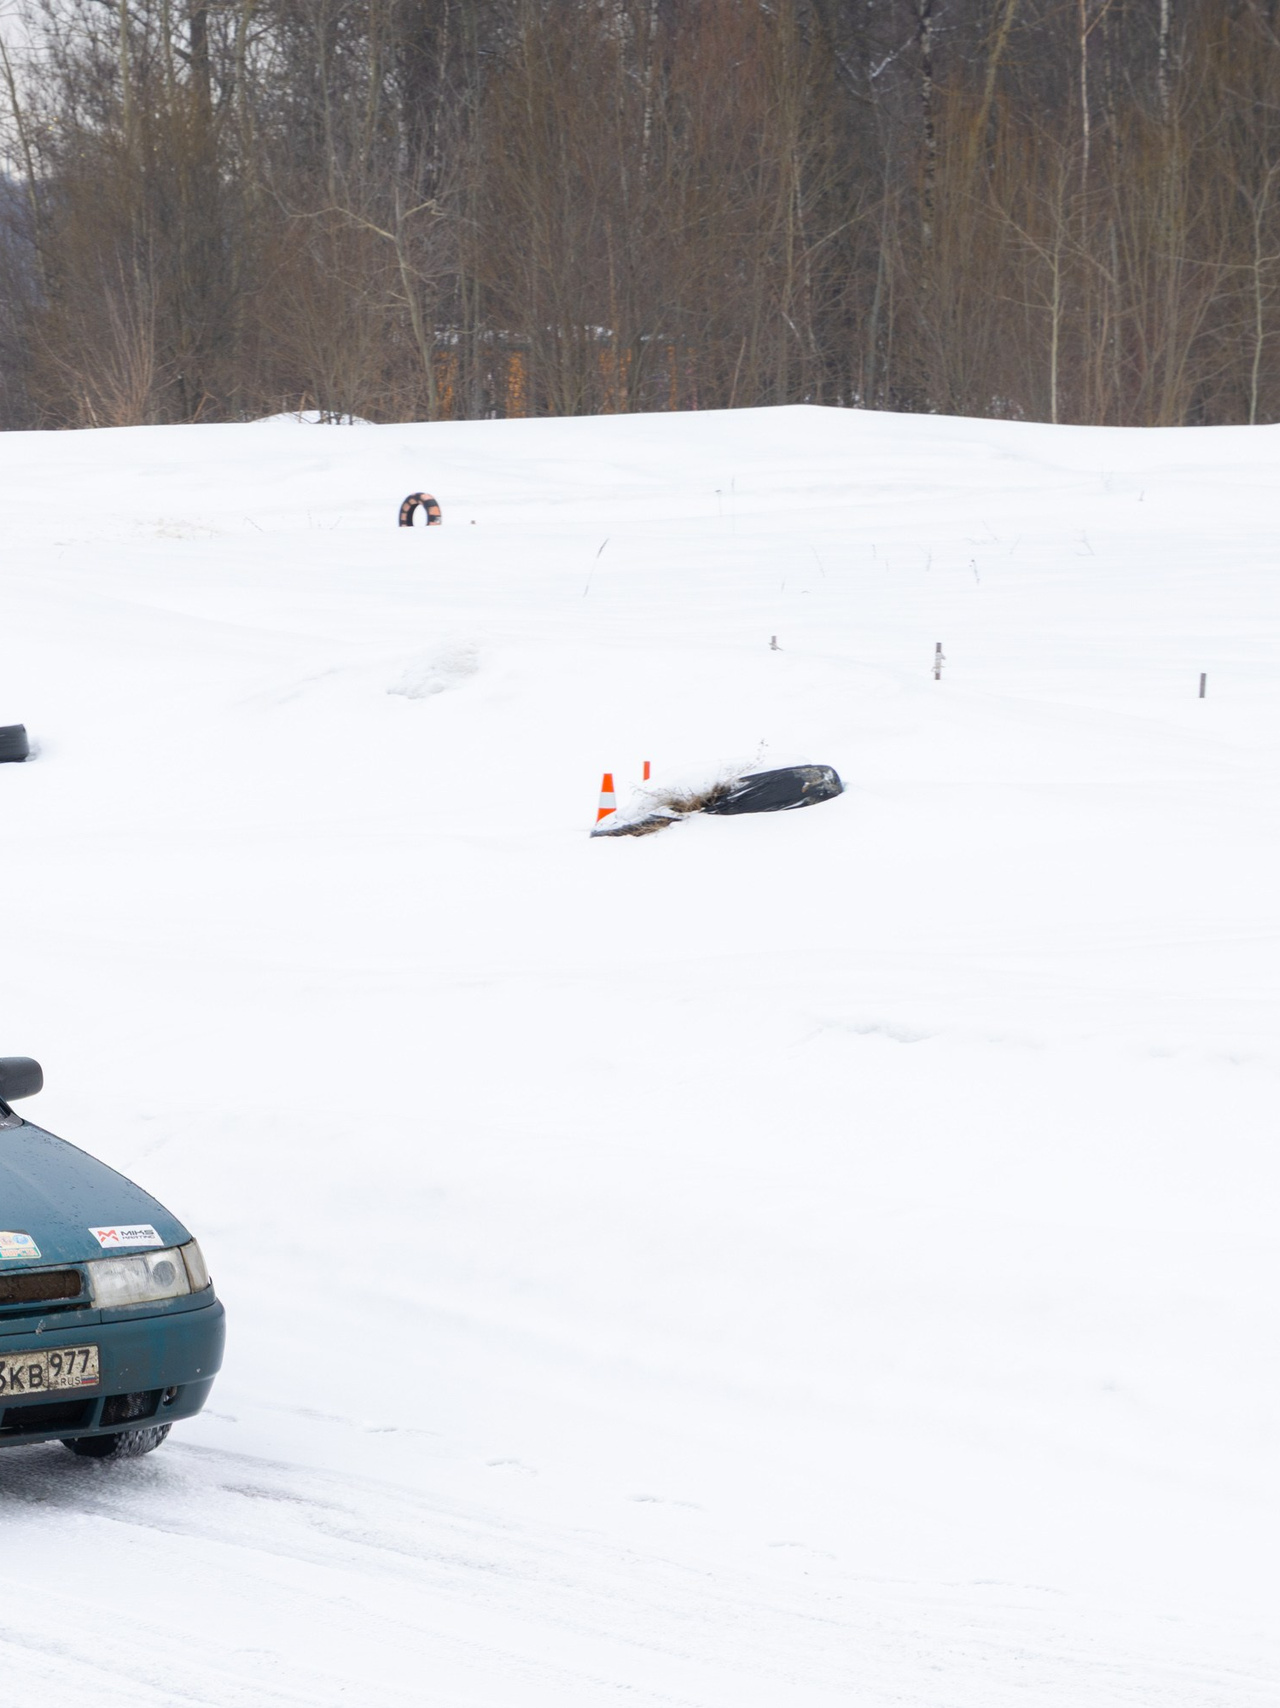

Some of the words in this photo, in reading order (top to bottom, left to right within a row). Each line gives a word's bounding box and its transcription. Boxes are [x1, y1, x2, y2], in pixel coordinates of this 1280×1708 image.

[121, 1229, 155, 1237] MIKS
[50, 1349, 90, 1377] 977
[60, 1376, 81, 1387] RUS
